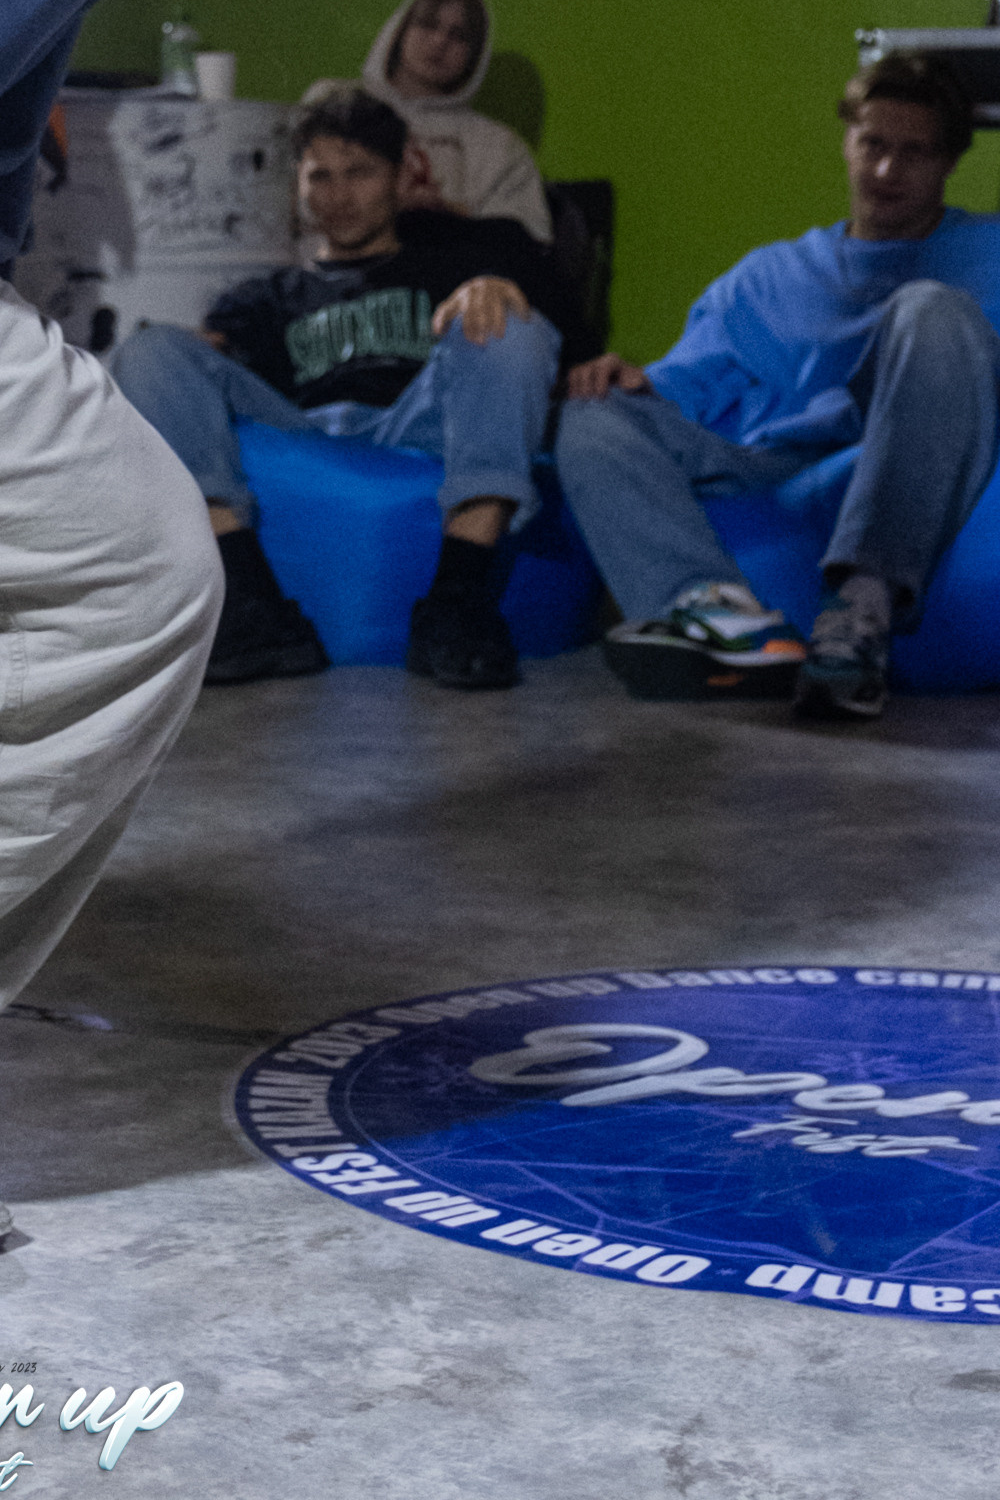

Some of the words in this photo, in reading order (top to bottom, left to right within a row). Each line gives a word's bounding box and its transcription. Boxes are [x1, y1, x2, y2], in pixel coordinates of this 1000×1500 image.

[248, 1069, 344, 1139] KAZAN
[732, 1114, 981, 1158] Fest
[272, 1142, 421, 1195] FEST
[383, 1191, 501, 1227] up
[480, 1219, 711, 1283] Open
